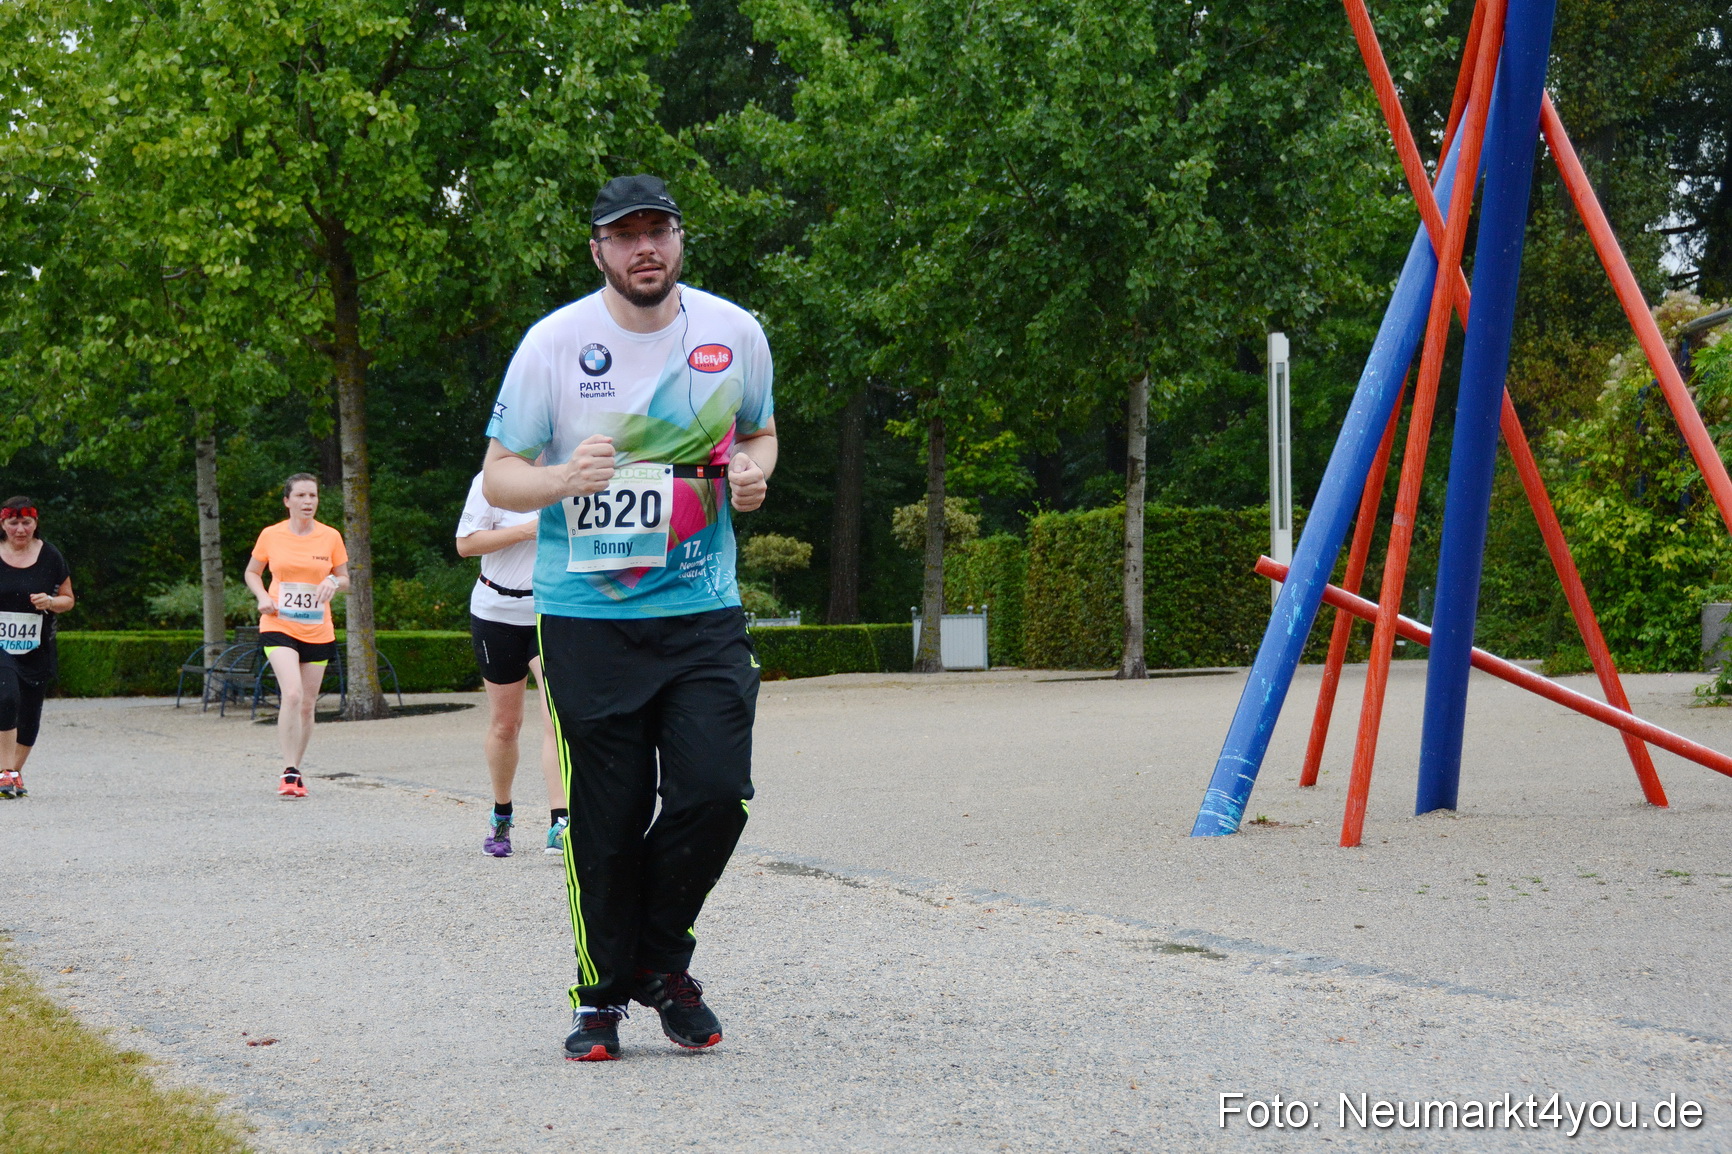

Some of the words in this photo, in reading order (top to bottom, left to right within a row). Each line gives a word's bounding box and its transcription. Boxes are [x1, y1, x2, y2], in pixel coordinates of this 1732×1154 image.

[693, 352, 729, 366] Hervis
[579, 382, 615, 391] PARTL
[580, 390, 616, 398] Neumarkt
[573, 489, 662, 530] 2520
[593, 539, 633, 557] Ronny
[683, 540, 702, 559] 17.
[0, 622, 37, 638] 3044
